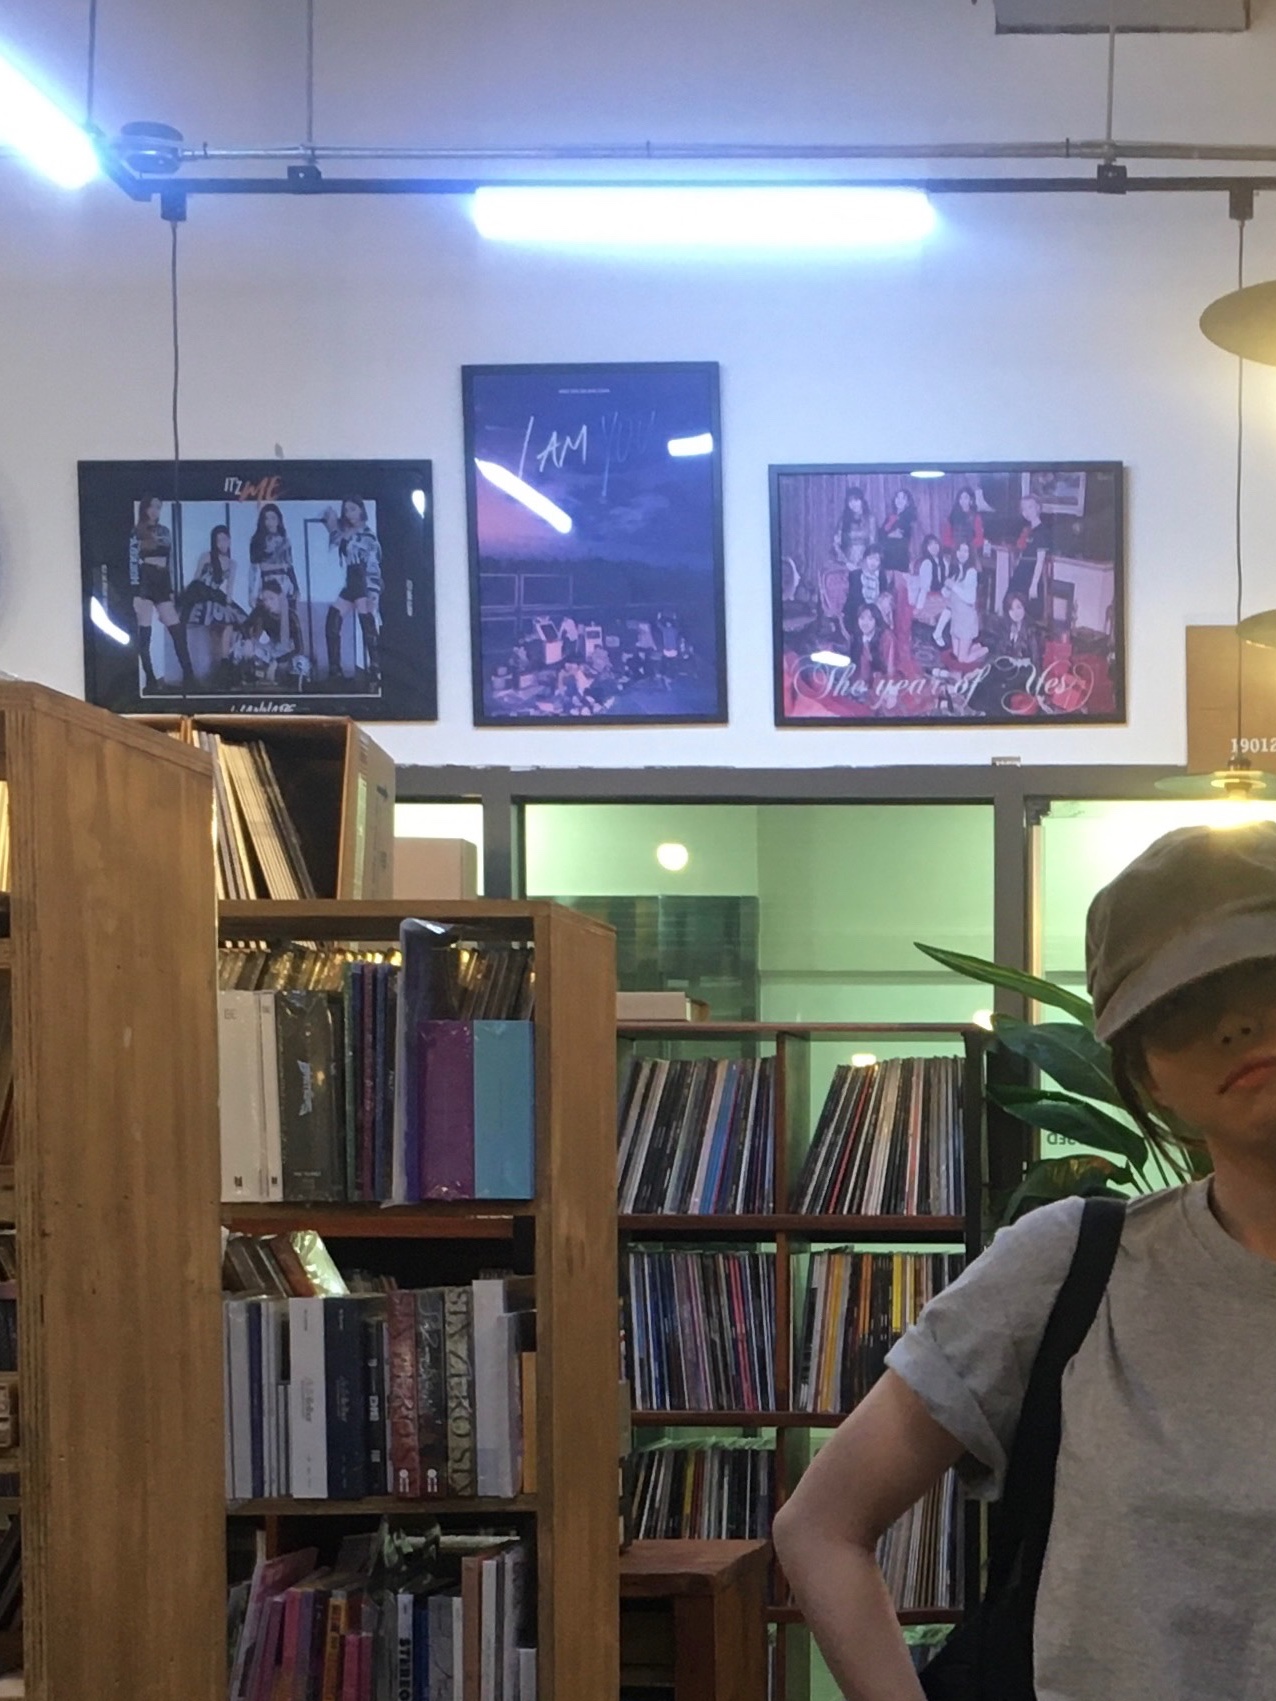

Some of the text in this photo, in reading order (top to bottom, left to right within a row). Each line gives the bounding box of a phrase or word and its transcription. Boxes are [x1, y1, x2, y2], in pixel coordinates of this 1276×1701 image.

[537, 424, 588, 473] AM
[794, 655, 1095, 714] The year of Yes
